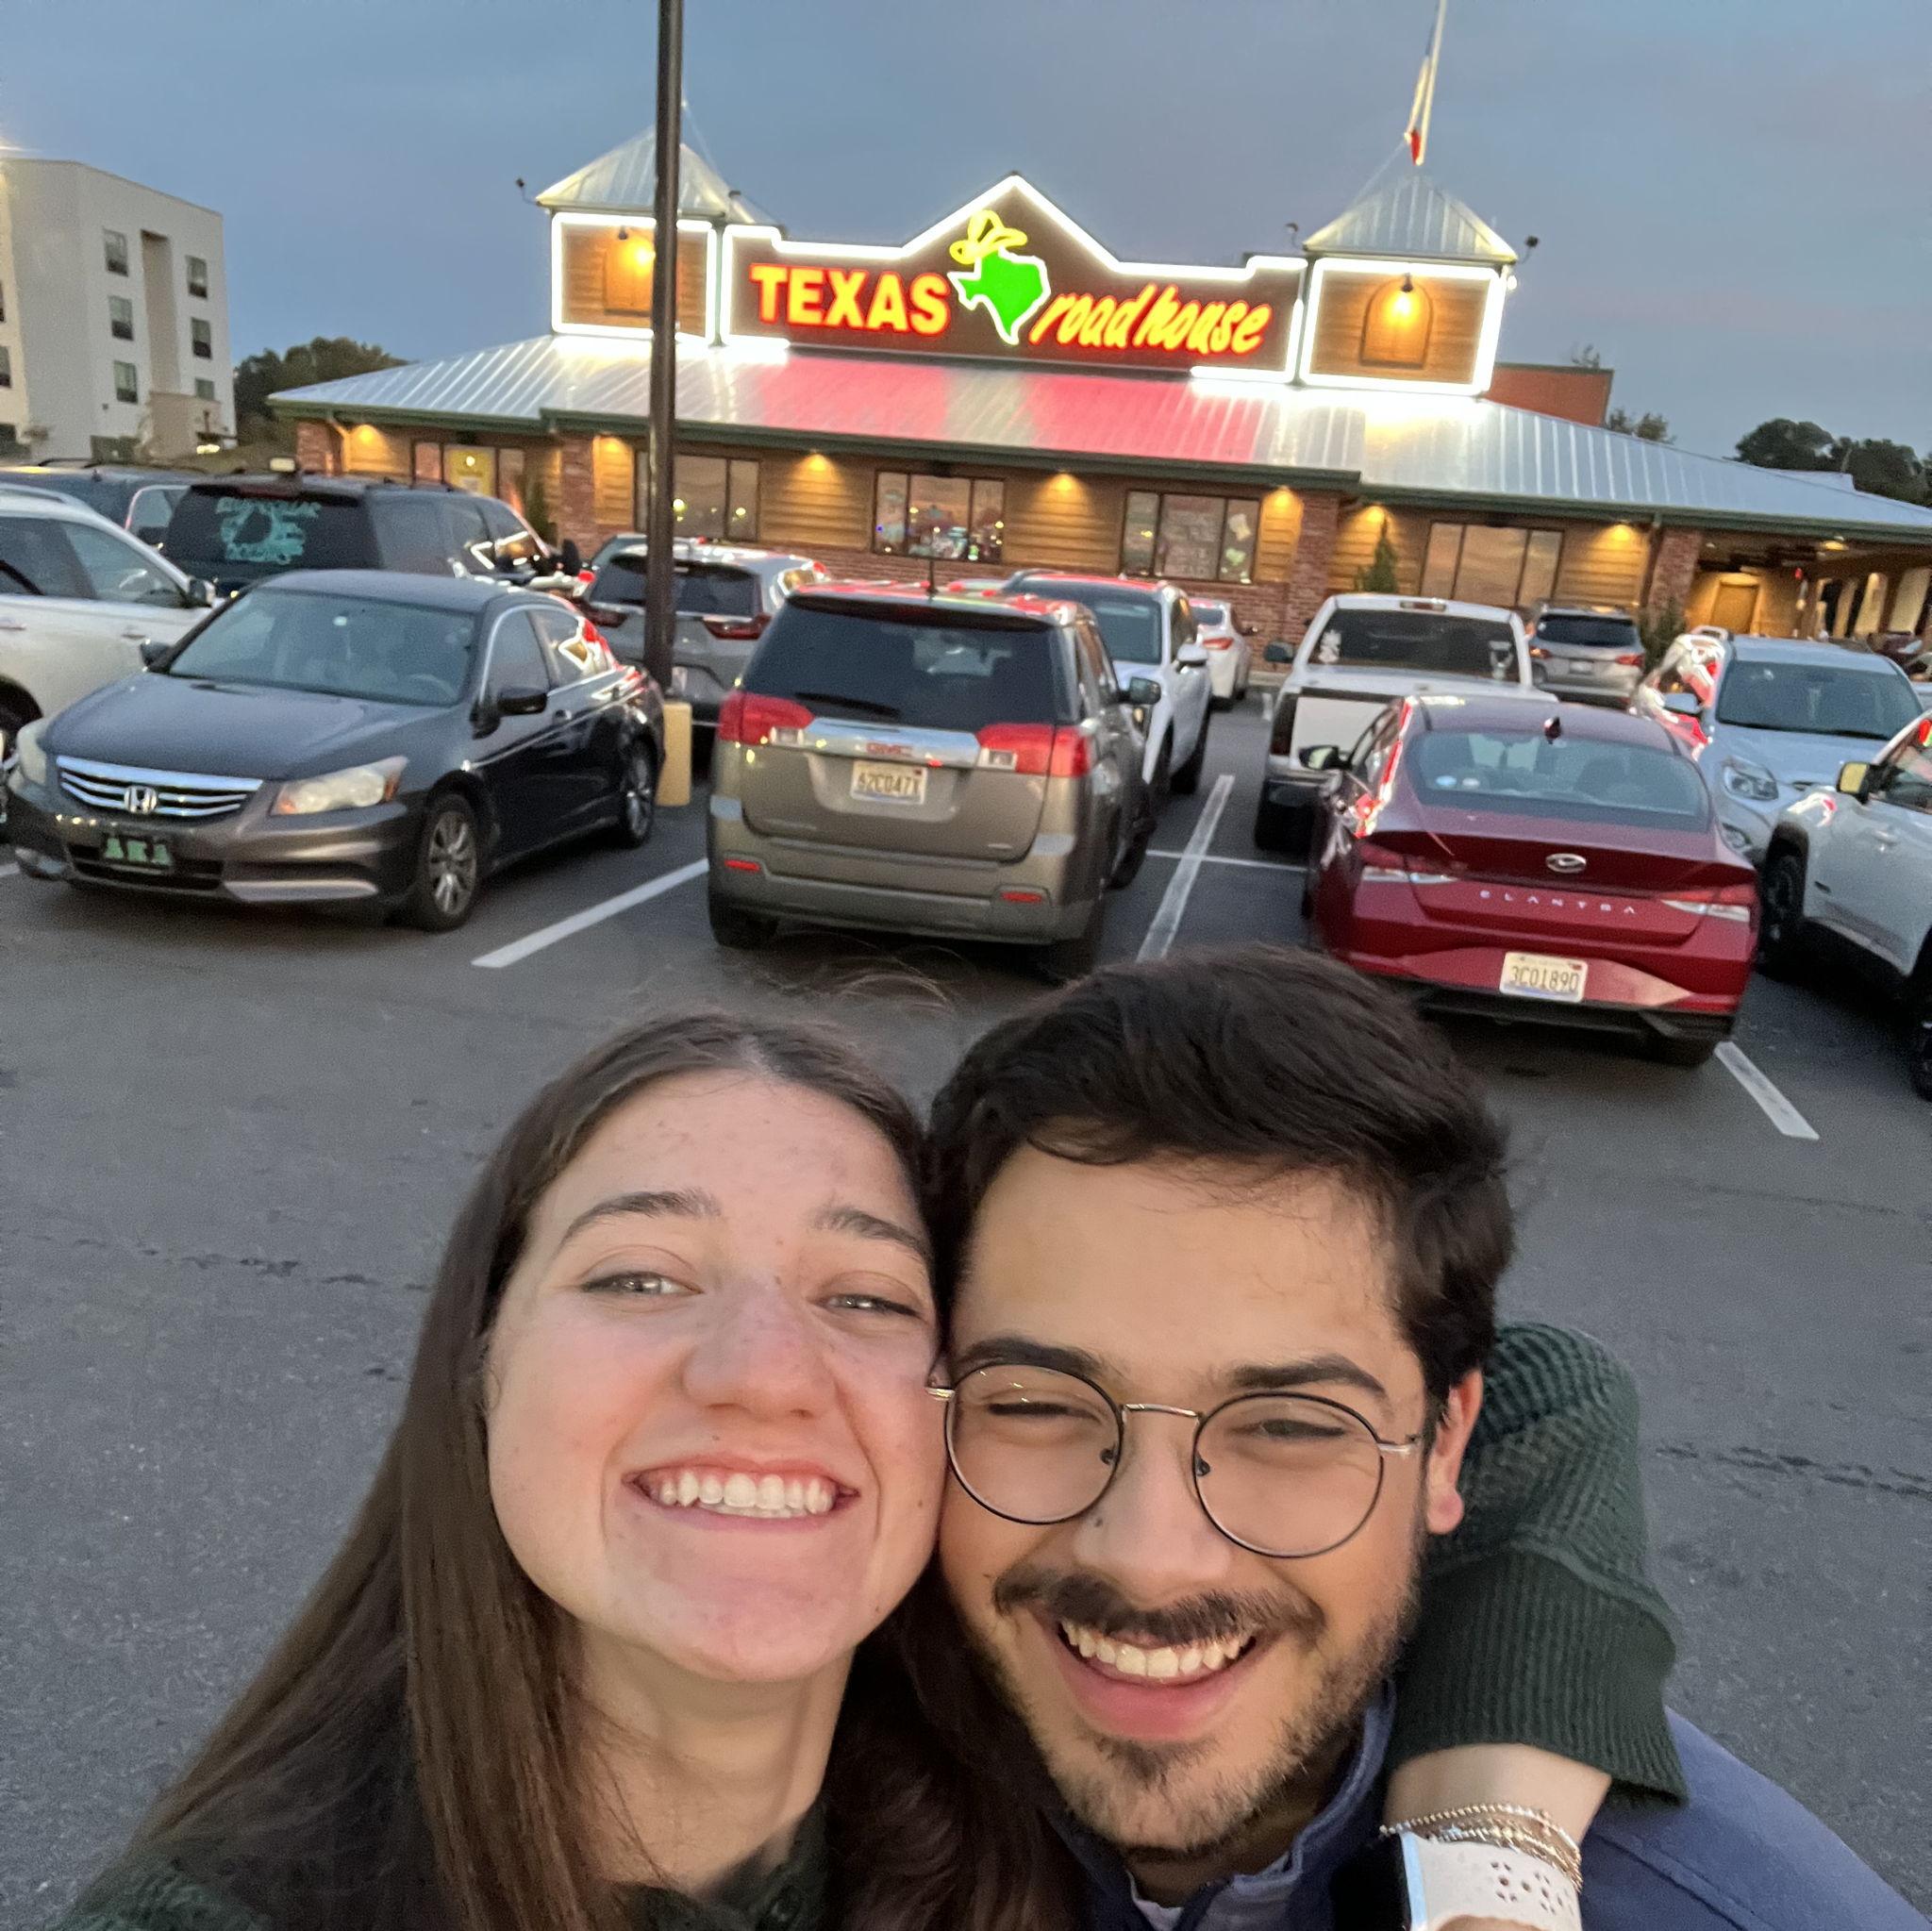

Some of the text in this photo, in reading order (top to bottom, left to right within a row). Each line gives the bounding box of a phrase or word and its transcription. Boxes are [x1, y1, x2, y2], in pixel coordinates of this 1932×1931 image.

[749, 262, 1273, 355] TEXAS roadhouse
[1479, 890, 1635, 914] ELANTRA
